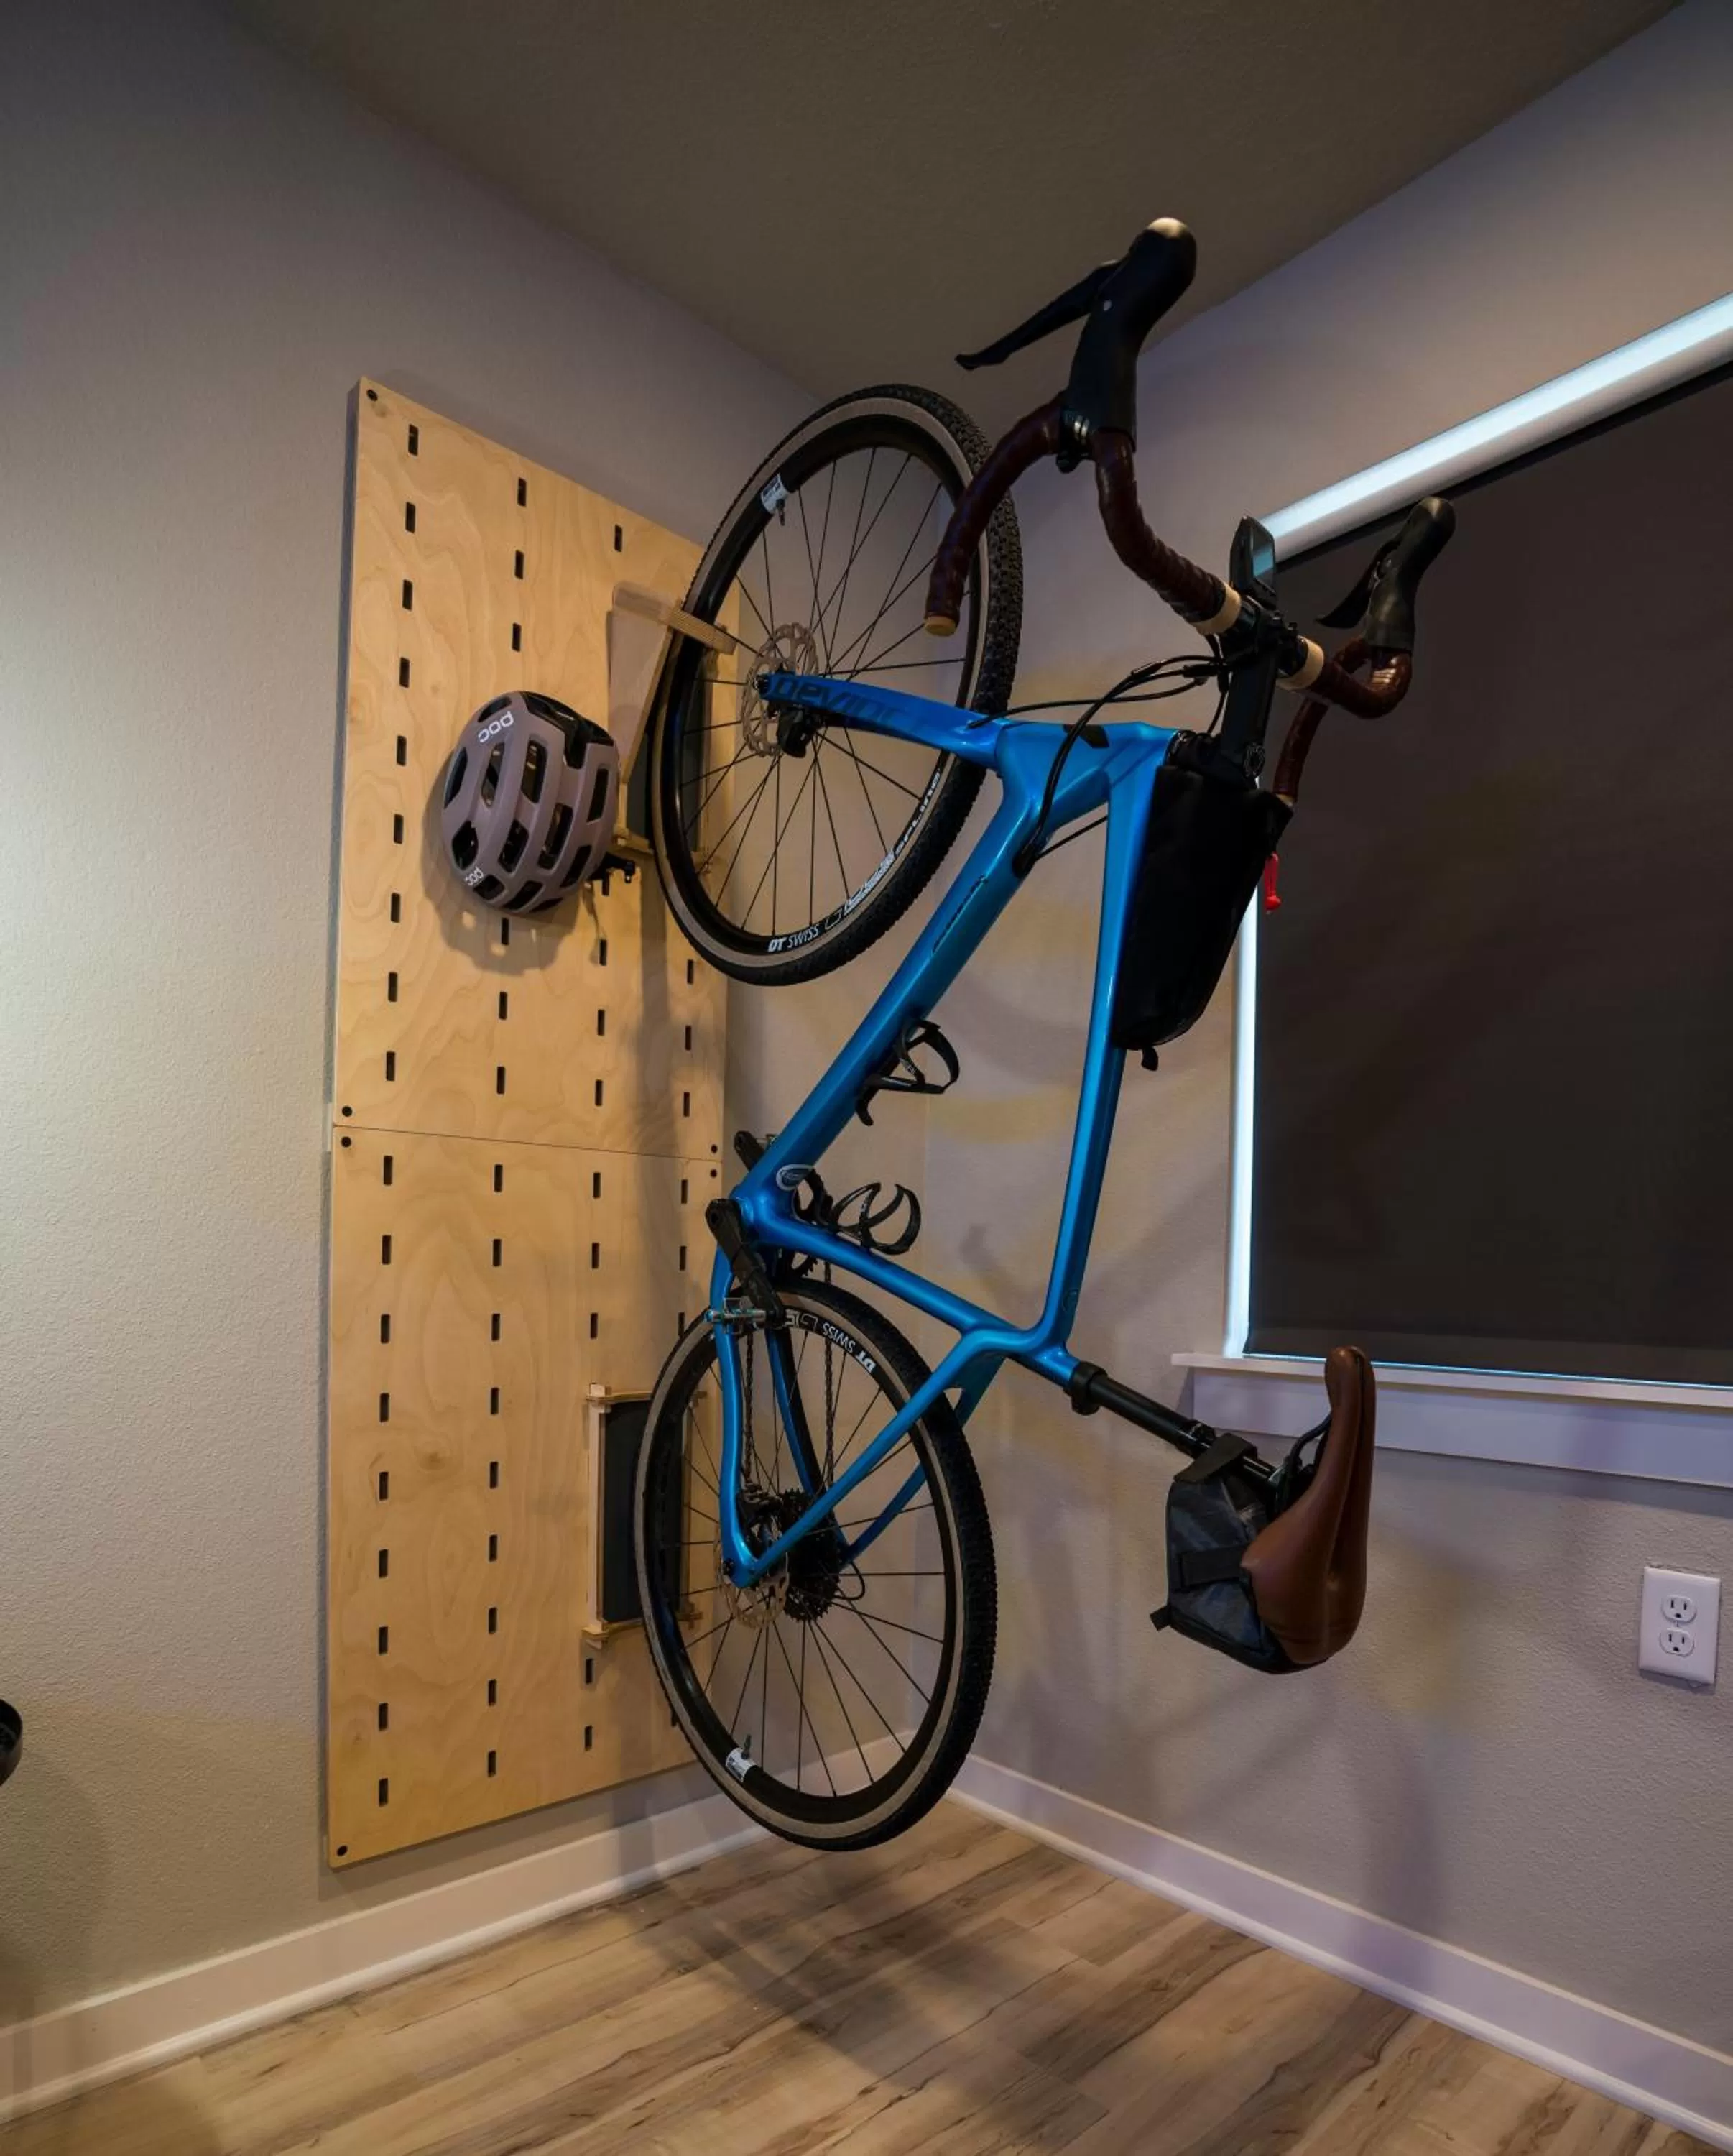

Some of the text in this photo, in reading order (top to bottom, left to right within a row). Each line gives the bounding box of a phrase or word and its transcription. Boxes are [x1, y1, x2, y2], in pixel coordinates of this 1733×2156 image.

[768, 926, 819, 952] DT SWISS
[822, 1322, 876, 1373] DT SWISS
